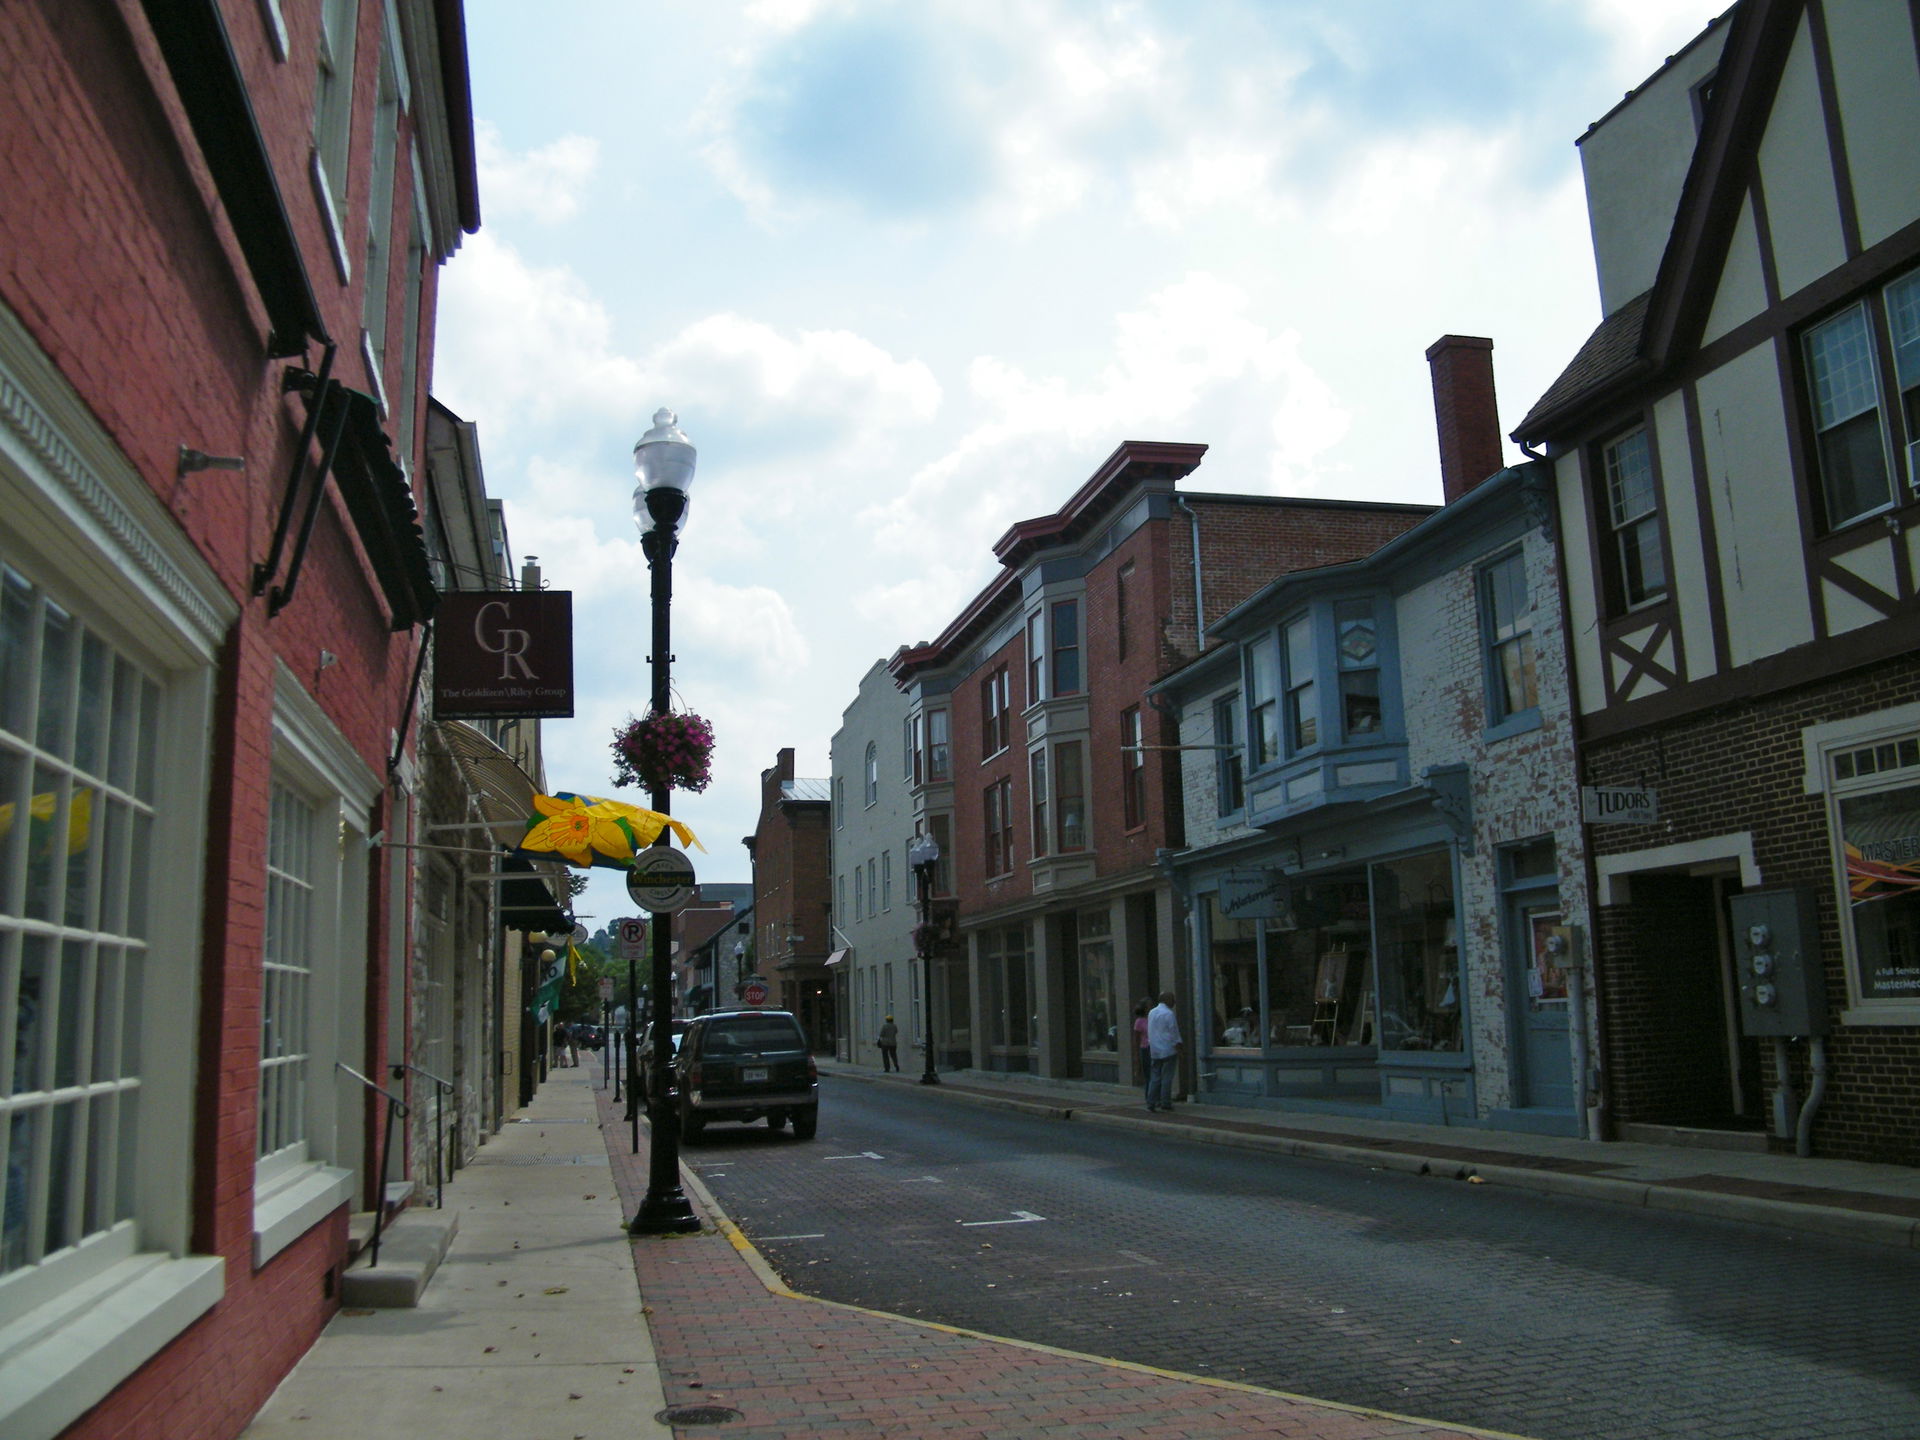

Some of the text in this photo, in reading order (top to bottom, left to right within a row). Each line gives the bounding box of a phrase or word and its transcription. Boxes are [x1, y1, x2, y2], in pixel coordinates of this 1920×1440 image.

[442, 689, 460, 698] The
[535, 687, 566, 698] Group
[1596, 792, 1649, 816] TUDORS
[1861, 837, 1920, 861] MASTER
[746, 991, 765, 1001] STOP
